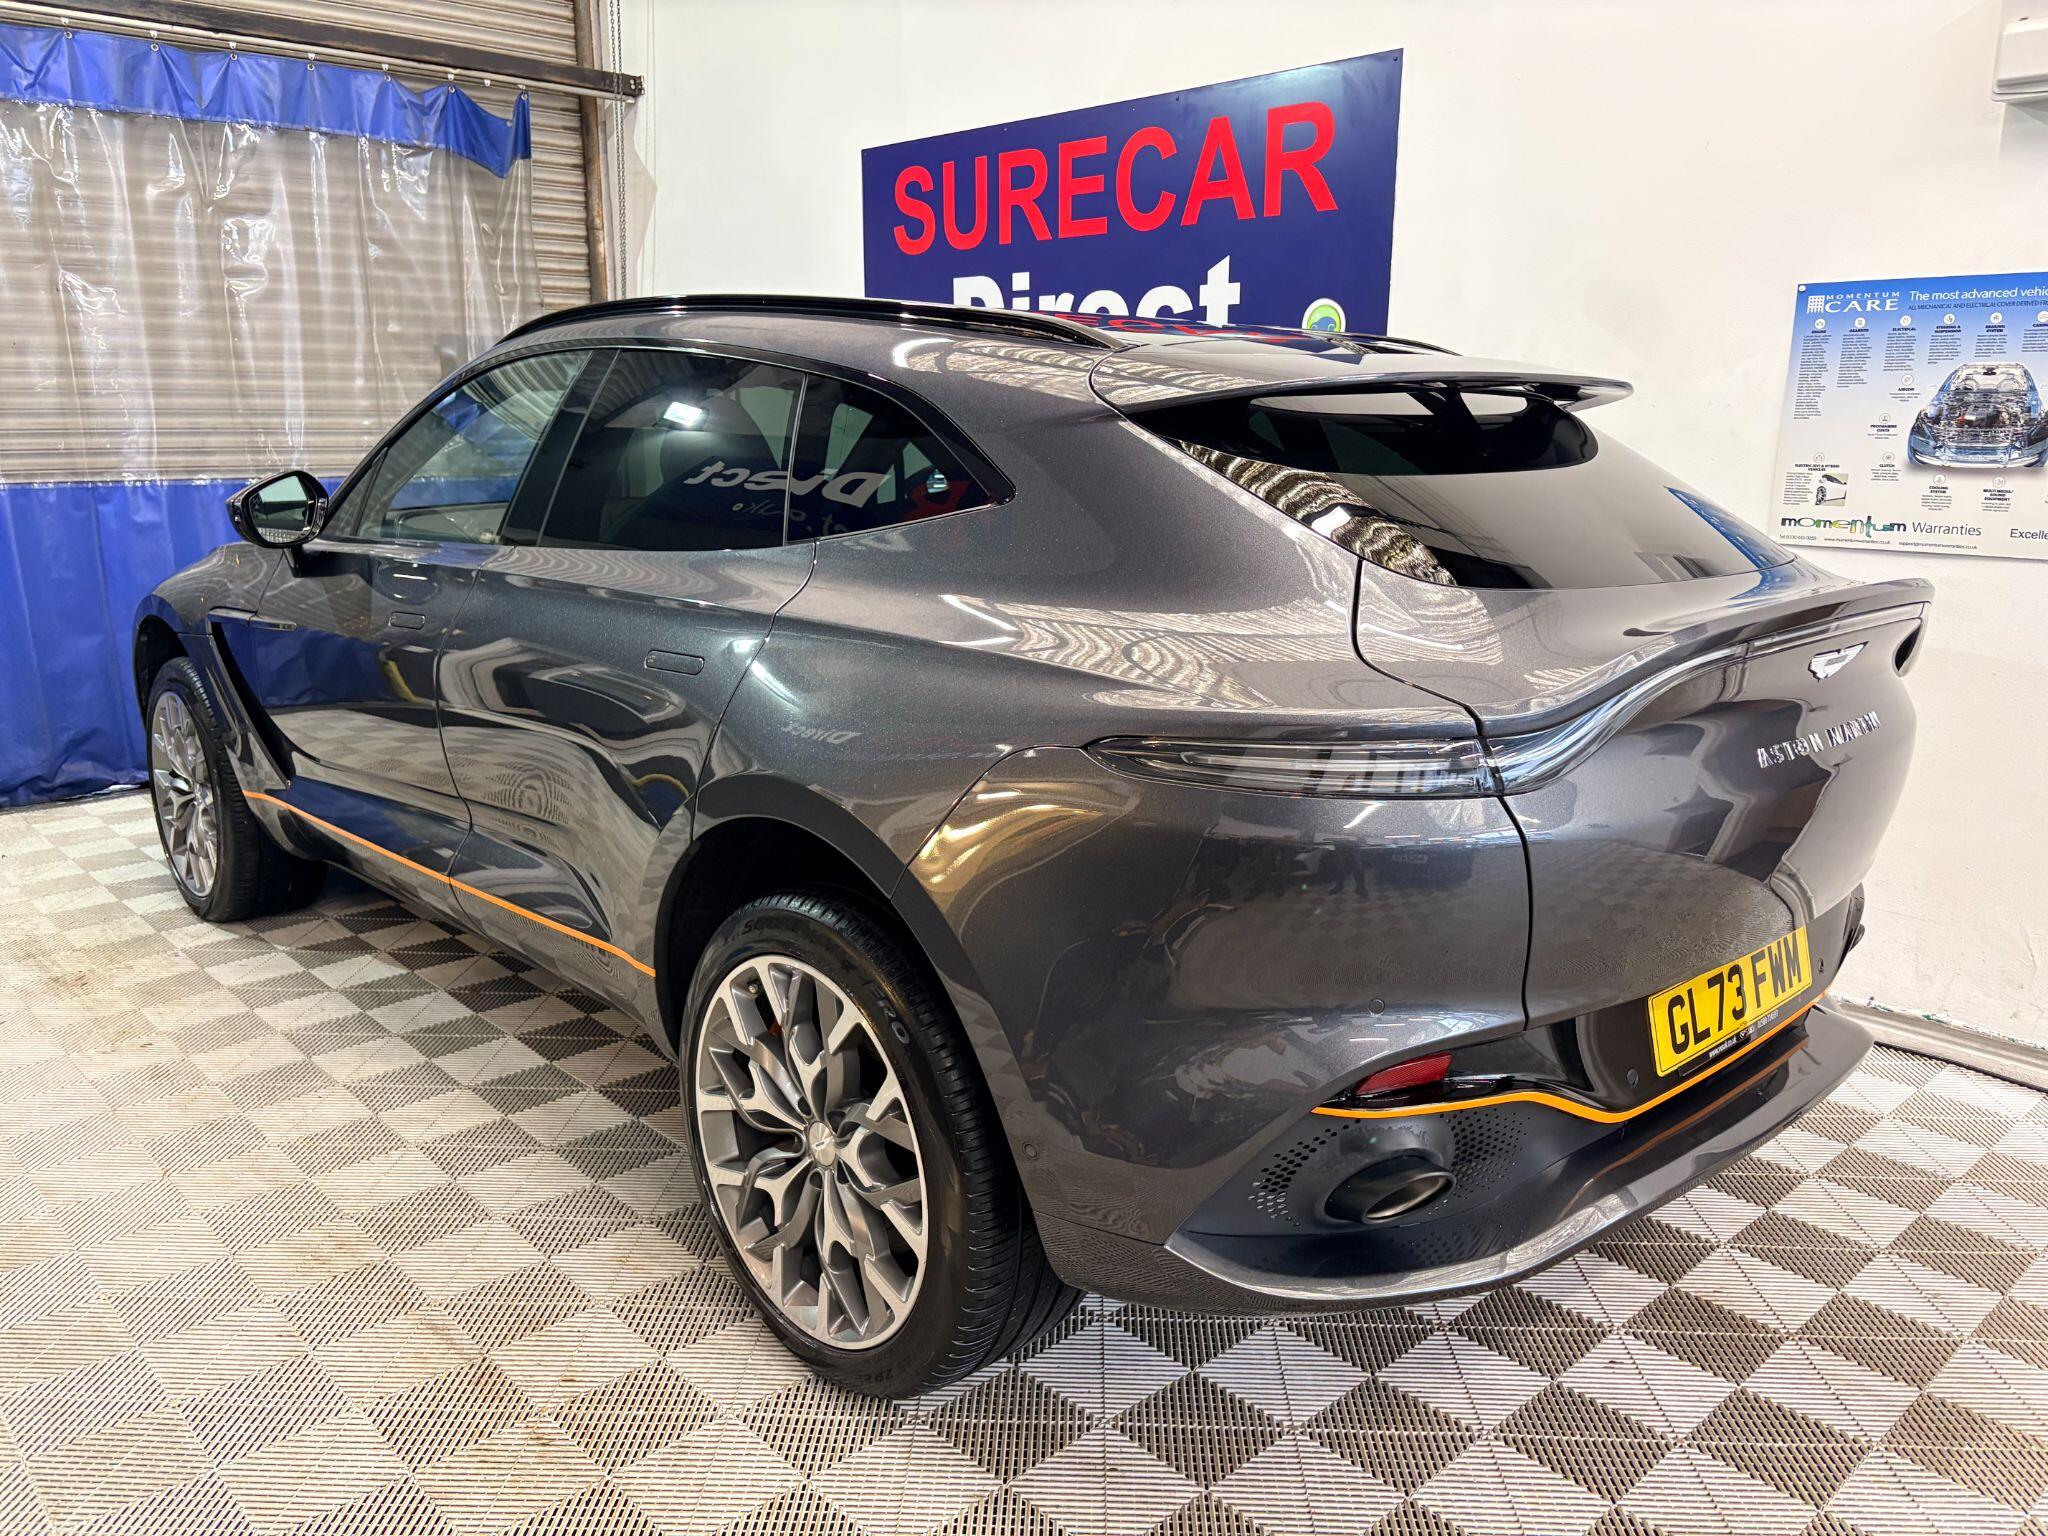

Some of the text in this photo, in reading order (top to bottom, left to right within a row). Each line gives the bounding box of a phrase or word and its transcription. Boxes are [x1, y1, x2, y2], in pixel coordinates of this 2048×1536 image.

[893, 101, 1339, 255] SURECAR
[1824, 298, 1898, 313] CARE
[1826, 291, 1900, 300] MOMENTUM
[1909, 291, 1930, 301] The
[1932, 290, 1959, 300] most
[1961, 287, 2018, 299] advanced
[1780, 515, 1982, 538] momentum Warranties
[1756, 710, 1881, 769] ASTON MARTIN
[1667, 931, 1802, 1055] GL73 FWM
